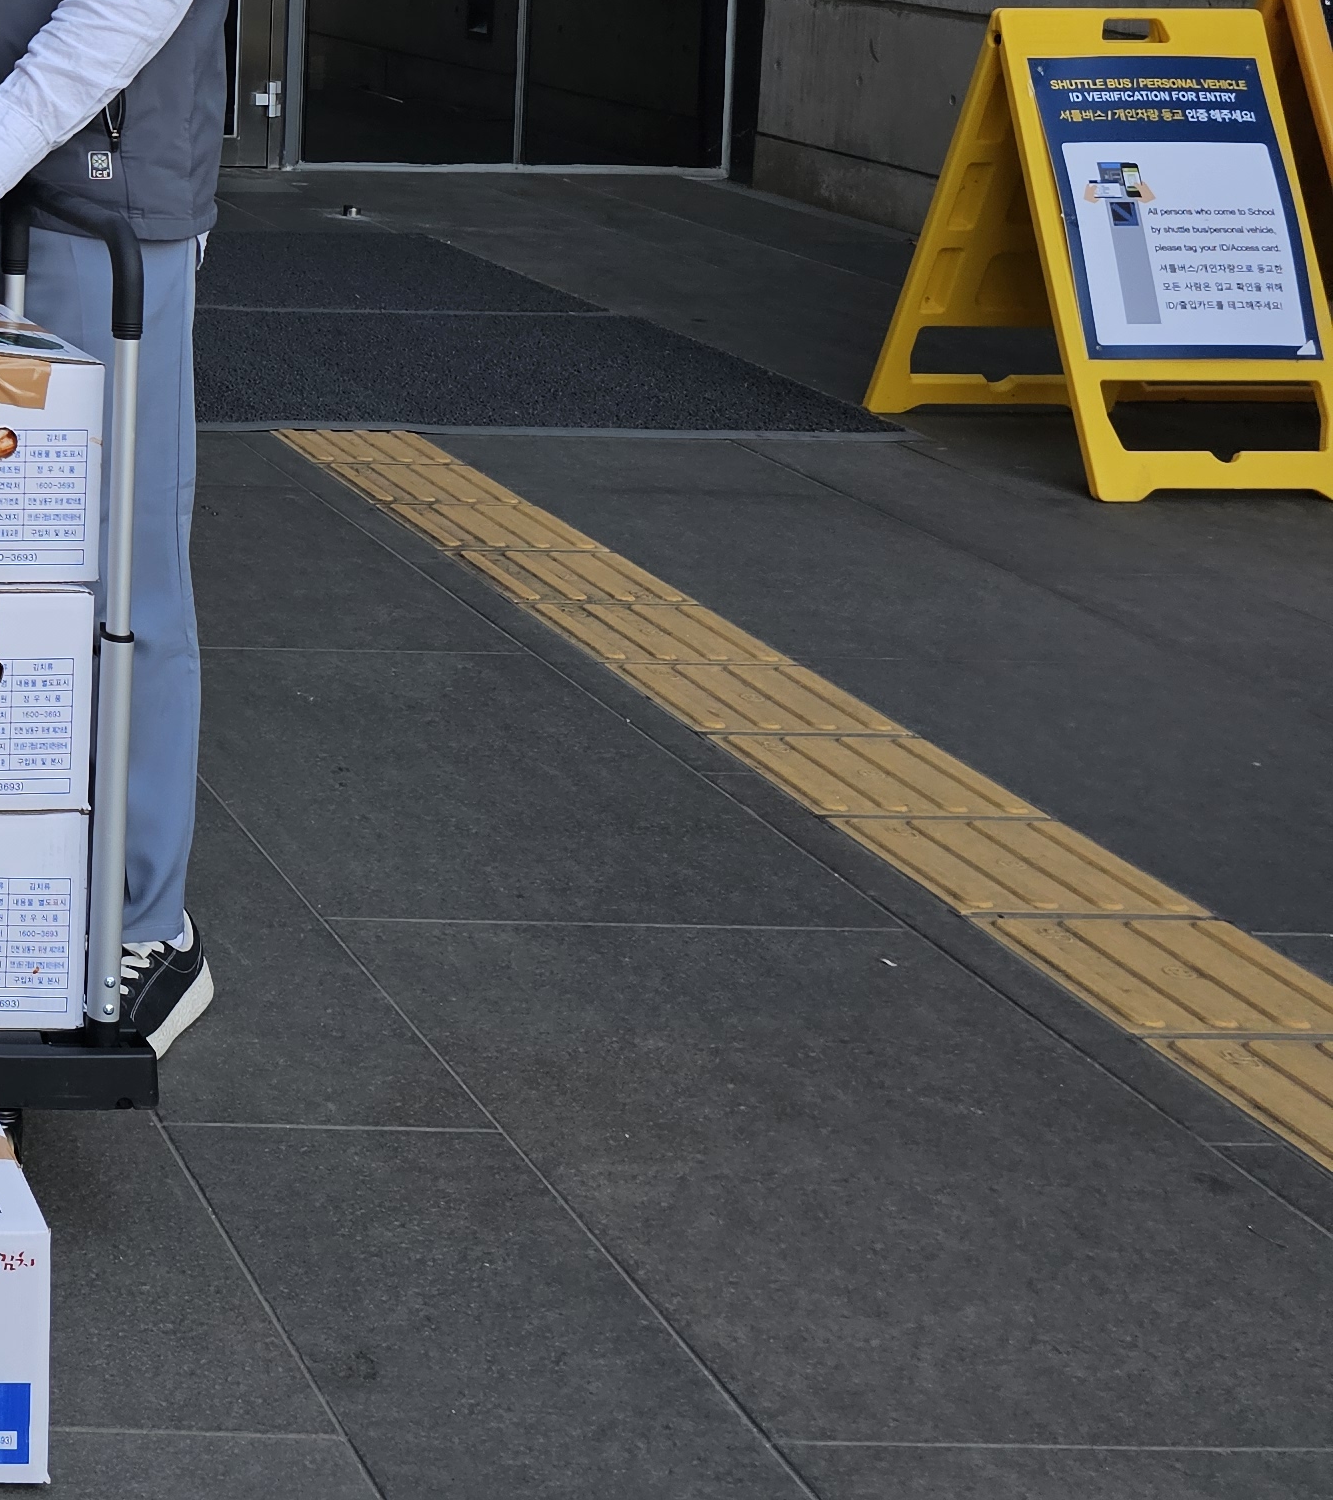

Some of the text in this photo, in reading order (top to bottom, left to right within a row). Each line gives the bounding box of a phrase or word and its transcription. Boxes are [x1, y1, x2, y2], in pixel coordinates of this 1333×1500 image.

[1050, 79, 1105, 89] SHUTTLE
[1106, 78, 1132, 89] BUS
[1139, 79, 1201, 89] PERSONAL
[1201, 79, 1248, 90] VEHICLE
[1069, 91, 1236, 102] ID VERIFICATION FOR ENTRY
[1059, 109, 1107, 122] 셔틀버스
[1114, 109, 1159, 122] 개인차량
[1161, 109, 1184, 121] 등교
[1185, 109, 1208, 122] 인증
[1210, 109, 1256, 123] 해주세요!
[1160, 208, 1193, 216] persons
[1247, 208, 1275, 216] School
[1151, 226, 1161, 235] by
[1192, 226, 1244, 235] bus/personal
[1154, 244, 1182, 252] please
[1184, 244, 1197, 253] tag
[1199, 245, 1217, 253] your
[1218, 244, 1259, 252] ID/Access
[1159, 264, 1254, 274] 셔틀버스/개인차량으로
[1162, 282, 1181, 291] 모든
[1184, 282, 1211, 291] 사람은
[1236, 282, 1262, 292] 확인을
[1265, 282, 1283, 292] 위해
